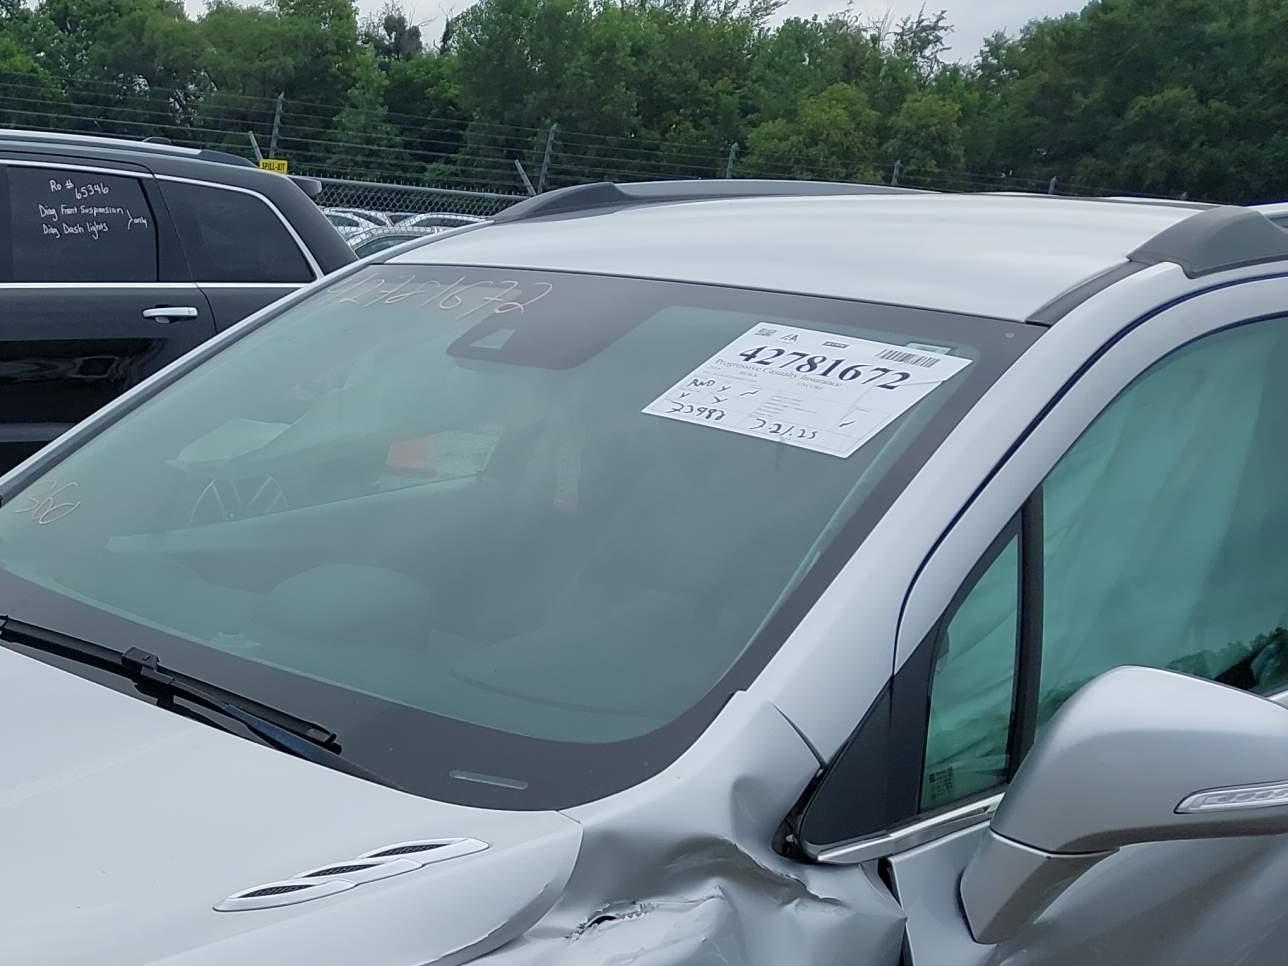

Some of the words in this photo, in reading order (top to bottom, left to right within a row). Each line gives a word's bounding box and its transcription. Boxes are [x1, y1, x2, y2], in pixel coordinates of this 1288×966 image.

[39, 204, 58, 221] Diag
[61, 204, 78, 215] Front
[80, 205, 123, 217] Suspension
[43, 223, 60, 238] Diag
[63, 222, 84, 235] Dash
[739, 345, 911, 391] 42781672
